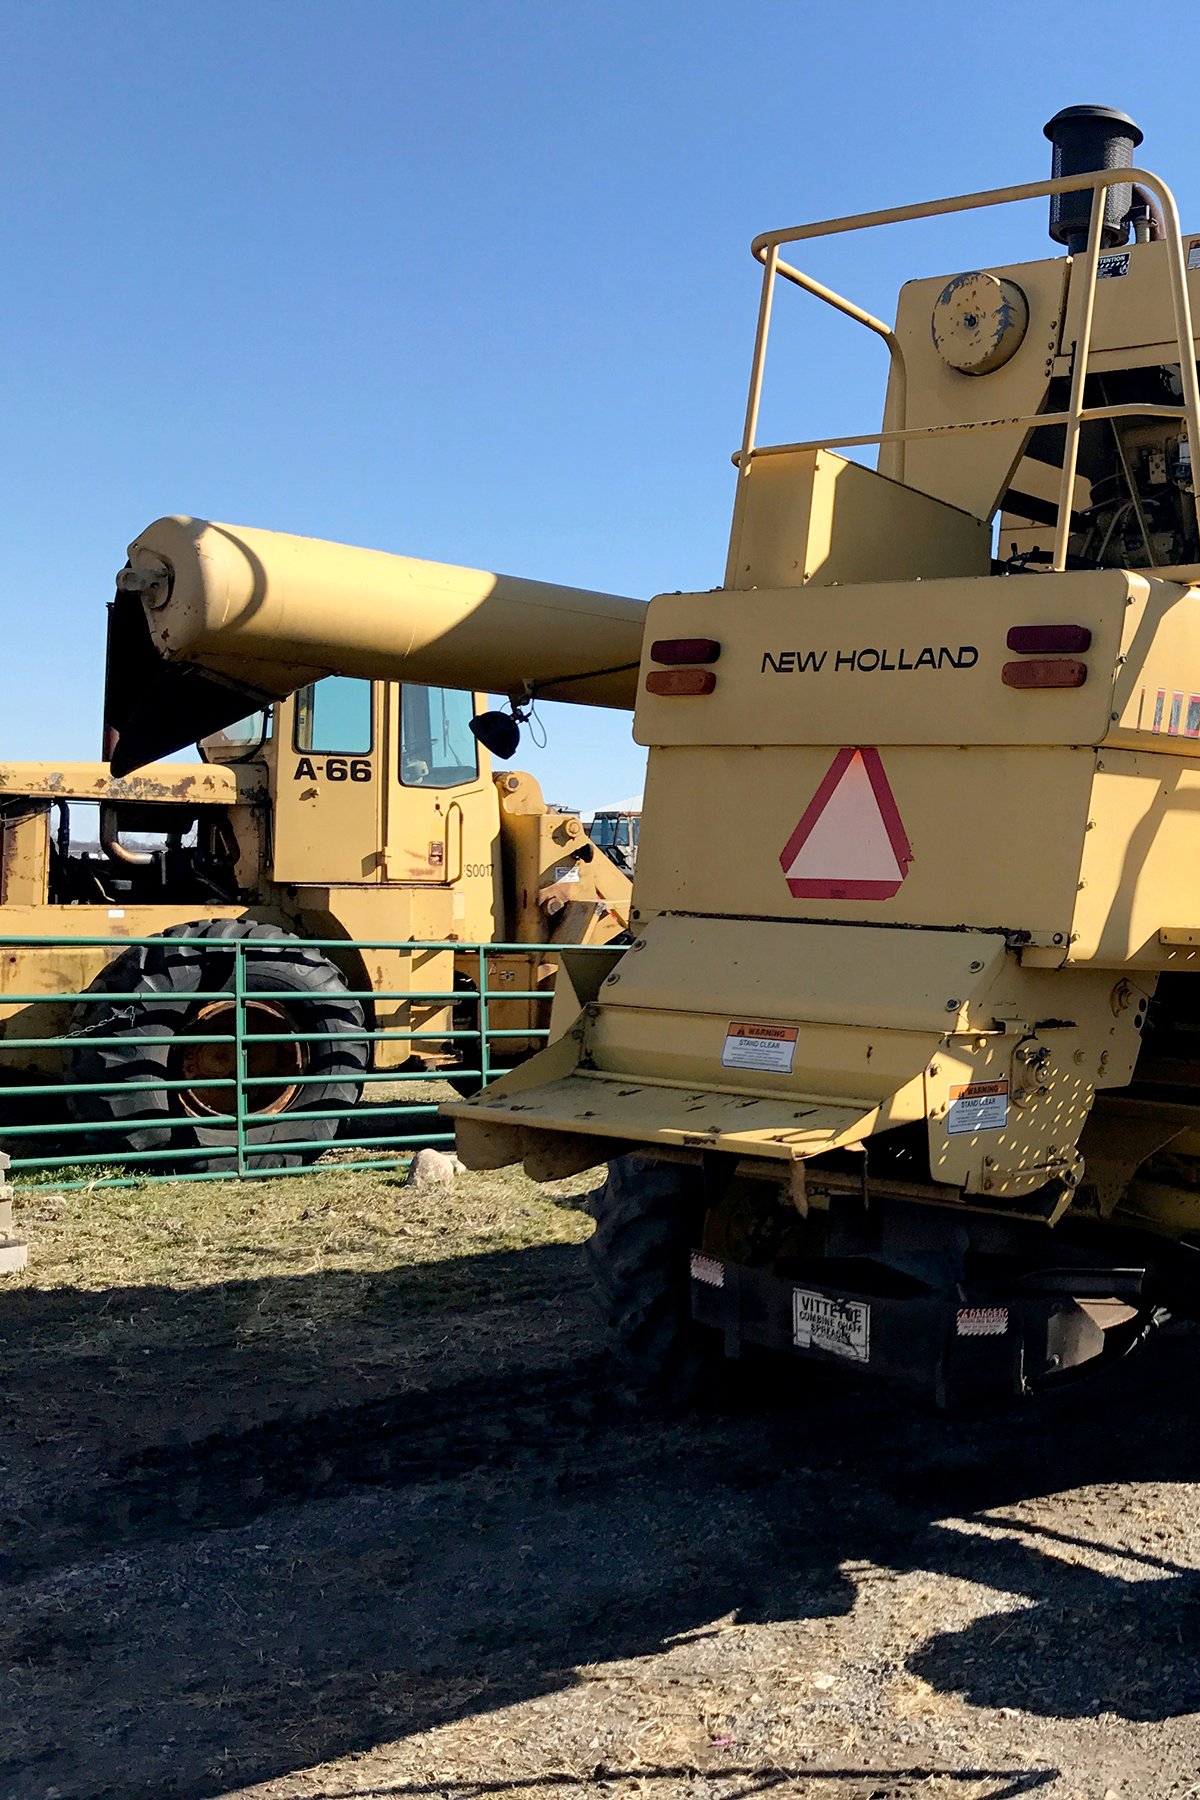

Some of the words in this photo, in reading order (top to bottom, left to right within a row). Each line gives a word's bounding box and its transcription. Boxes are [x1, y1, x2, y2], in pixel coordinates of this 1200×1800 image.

[760, 650, 828, 673] NEW
[834, 646, 979, 672] HOLLAND
[293, 757, 372, 782] A-66
[748, 1027, 786, 1038] WARNING
[739, 1039, 759, 1047] STAND
[759, 1040, 780, 1049] CLEAR
[967, 1084, 999, 1095] WARNING
[960, 1100, 979, 1109] STAND
